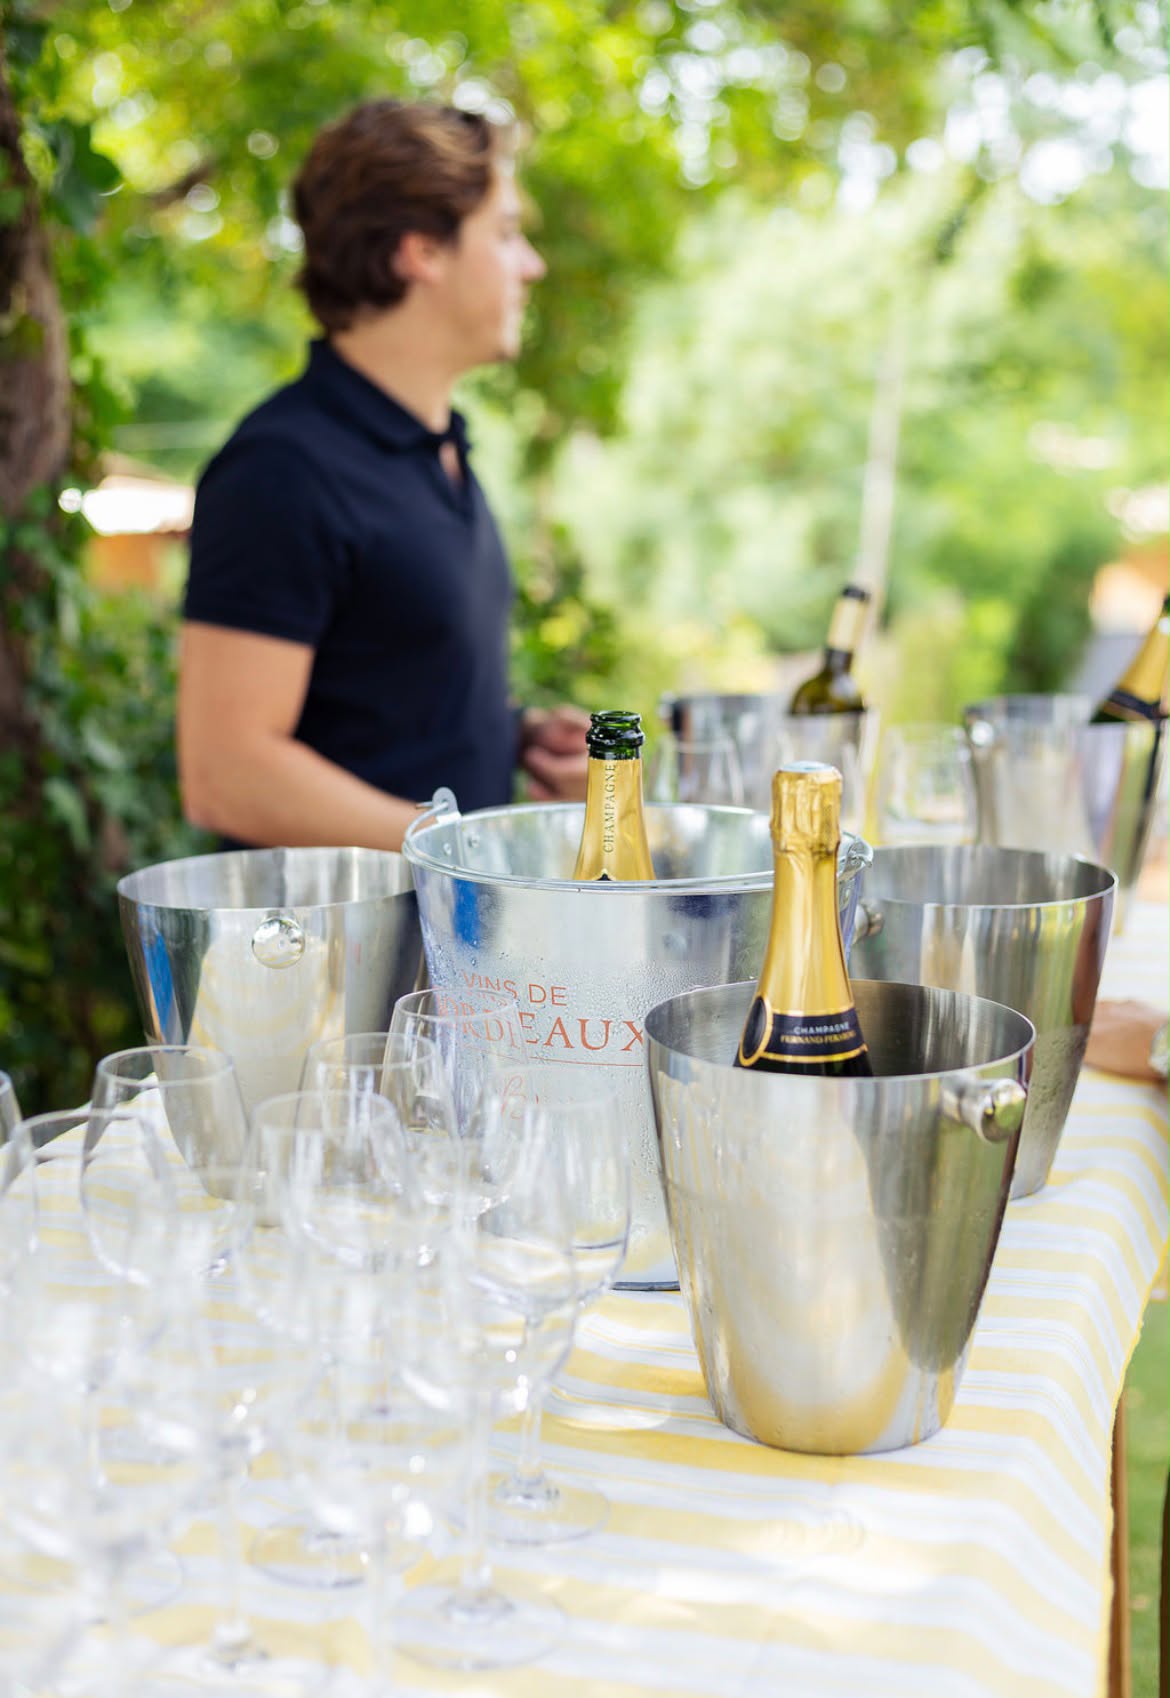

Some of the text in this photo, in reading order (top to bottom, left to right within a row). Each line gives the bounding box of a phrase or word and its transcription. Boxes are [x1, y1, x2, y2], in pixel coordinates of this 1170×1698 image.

[602, 764, 617, 853] CHAMPAGNE
[461, 969, 568, 1006] VINS DE
[793, 1021, 850, 1035] CHAMPAGNE
